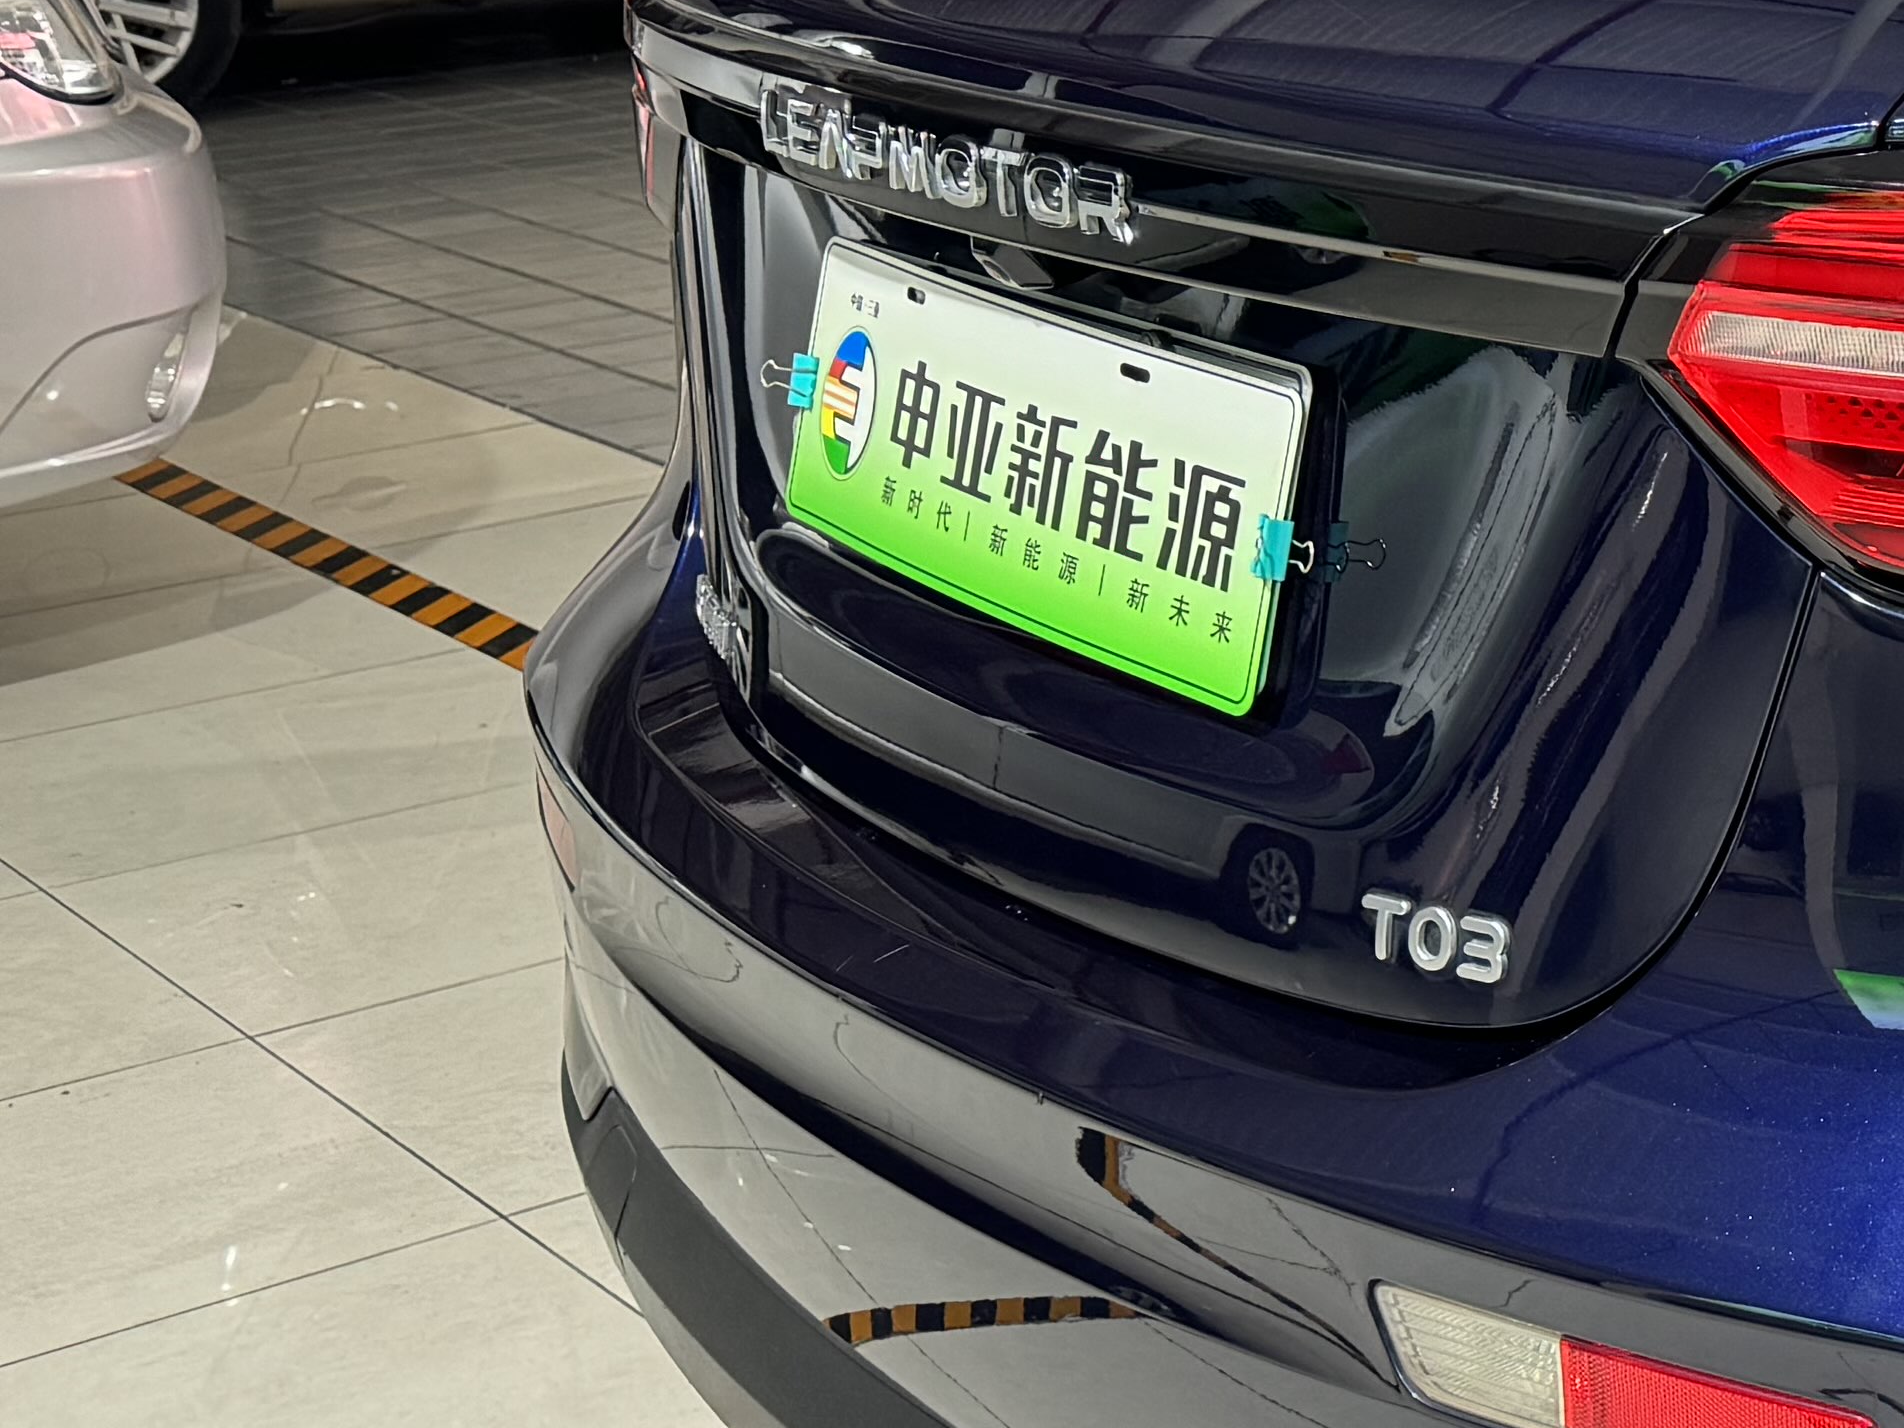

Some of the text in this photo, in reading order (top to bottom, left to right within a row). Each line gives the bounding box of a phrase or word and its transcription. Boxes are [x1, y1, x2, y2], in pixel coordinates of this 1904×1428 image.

[760, 90, 1134, 246] LEAPMOTOR
[889, 359, 1247, 593] 申亚新能源
[1361, 888, 1511, 984] T03
